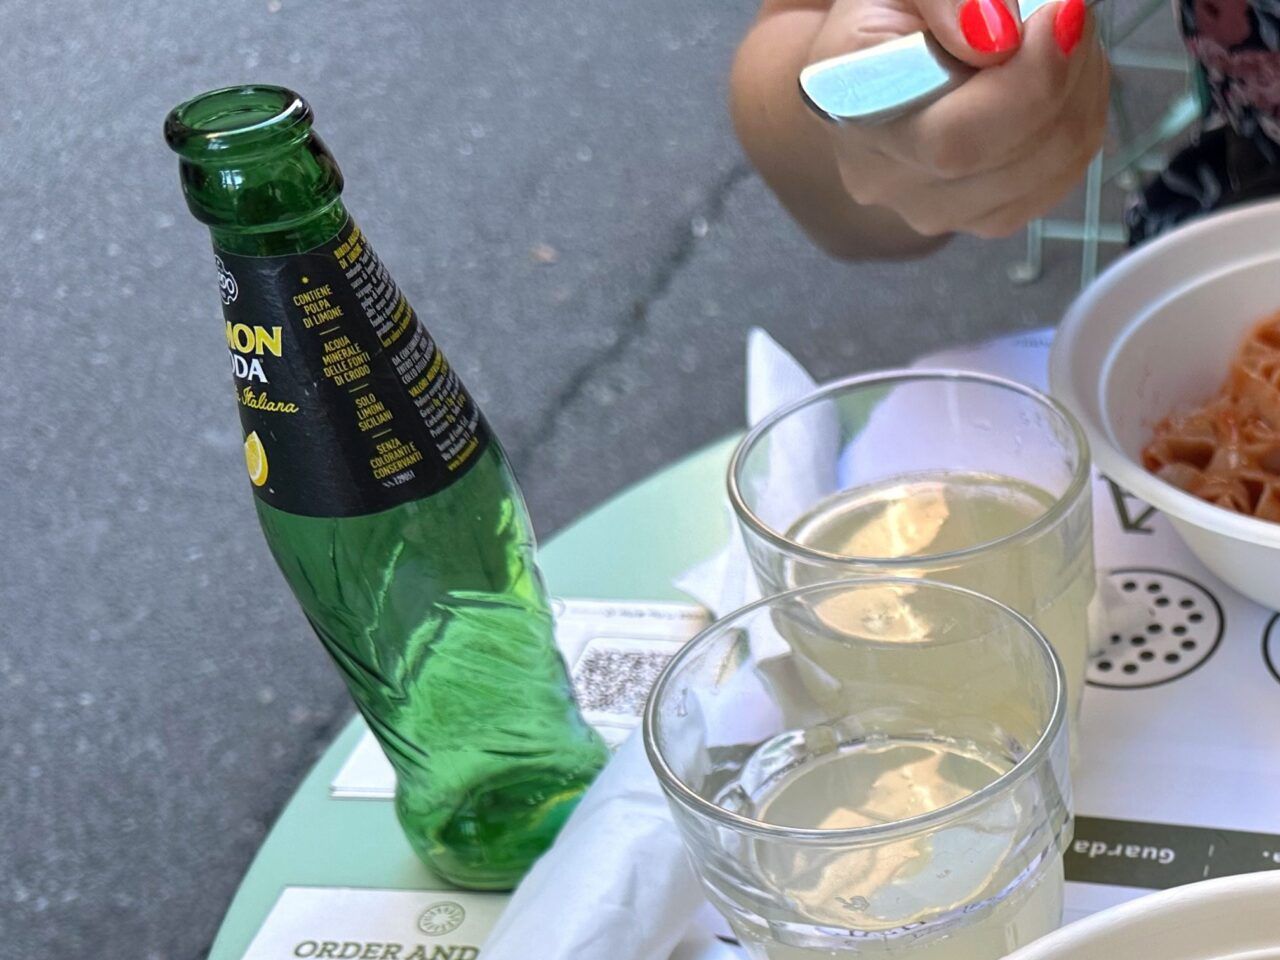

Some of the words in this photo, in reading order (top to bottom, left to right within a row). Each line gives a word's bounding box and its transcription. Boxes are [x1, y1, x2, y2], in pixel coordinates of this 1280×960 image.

[293, 284, 333, 306] CONTIENE
[302, 317, 314, 328] DI
[313, 305, 344, 325] LIMONE
[304, 298, 331, 315] POLPA
[322, 343, 362, 365] MINERALE
[324, 335, 351, 352] ACQUA
[323, 360, 348, 377] DELLE
[347, 351, 371, 368] FONTI
[334, 375, 345, 386] DI
[344, 364, 371, 382] CRODO
[355, 393, 376, 408] SOLO
[357, 401, 385, 420] LIMONI
[358, 410, 393, 431] SICILIANI
[370, 444, 412, 468] COLORANTI
[376, 437, 402, 454] SENZA
[372, 451, 423, 479] CONSERVANTI
[1074, 839, 1176, 864] Guarda
